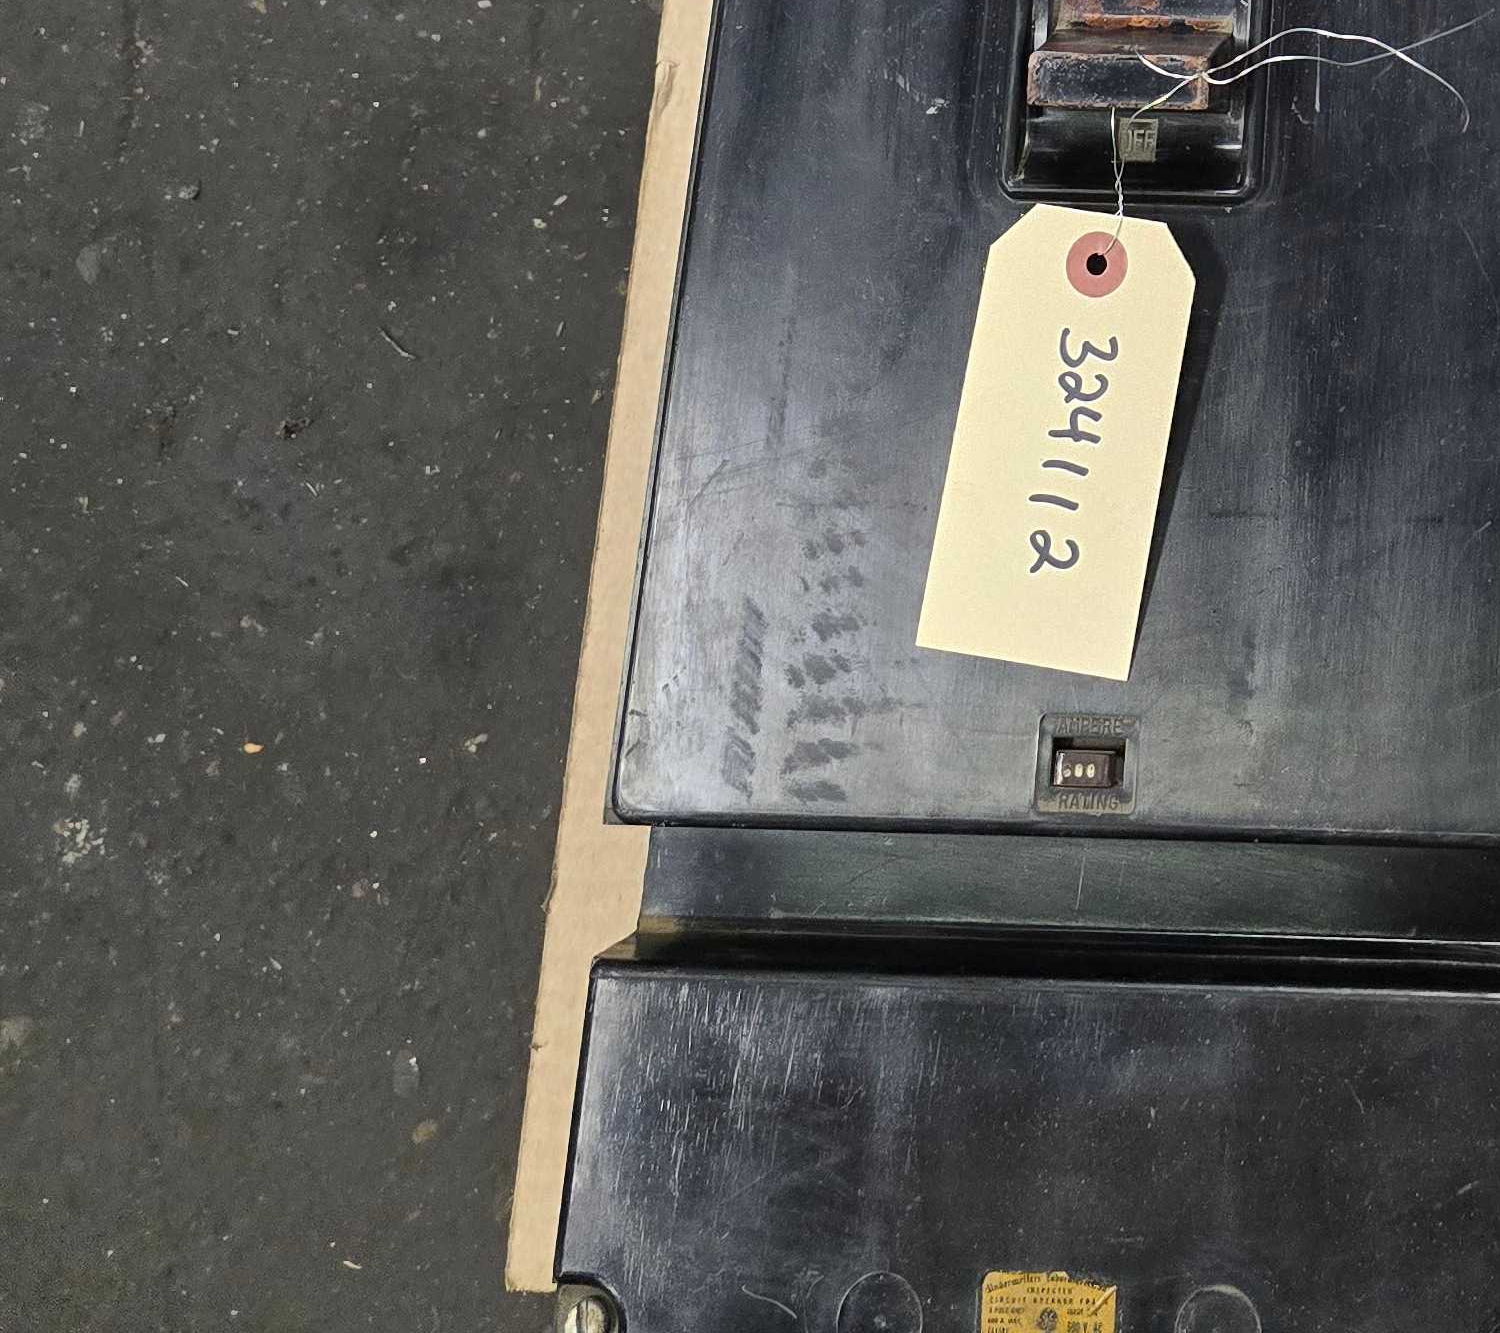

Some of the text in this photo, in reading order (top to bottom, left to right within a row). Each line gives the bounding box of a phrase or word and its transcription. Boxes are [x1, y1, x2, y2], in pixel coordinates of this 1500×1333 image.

[1028, 326, 1120, 575] 324112
[1056, 718, 1121, 734] AMPERE
[1058, 793, 1120, 810] RATING
